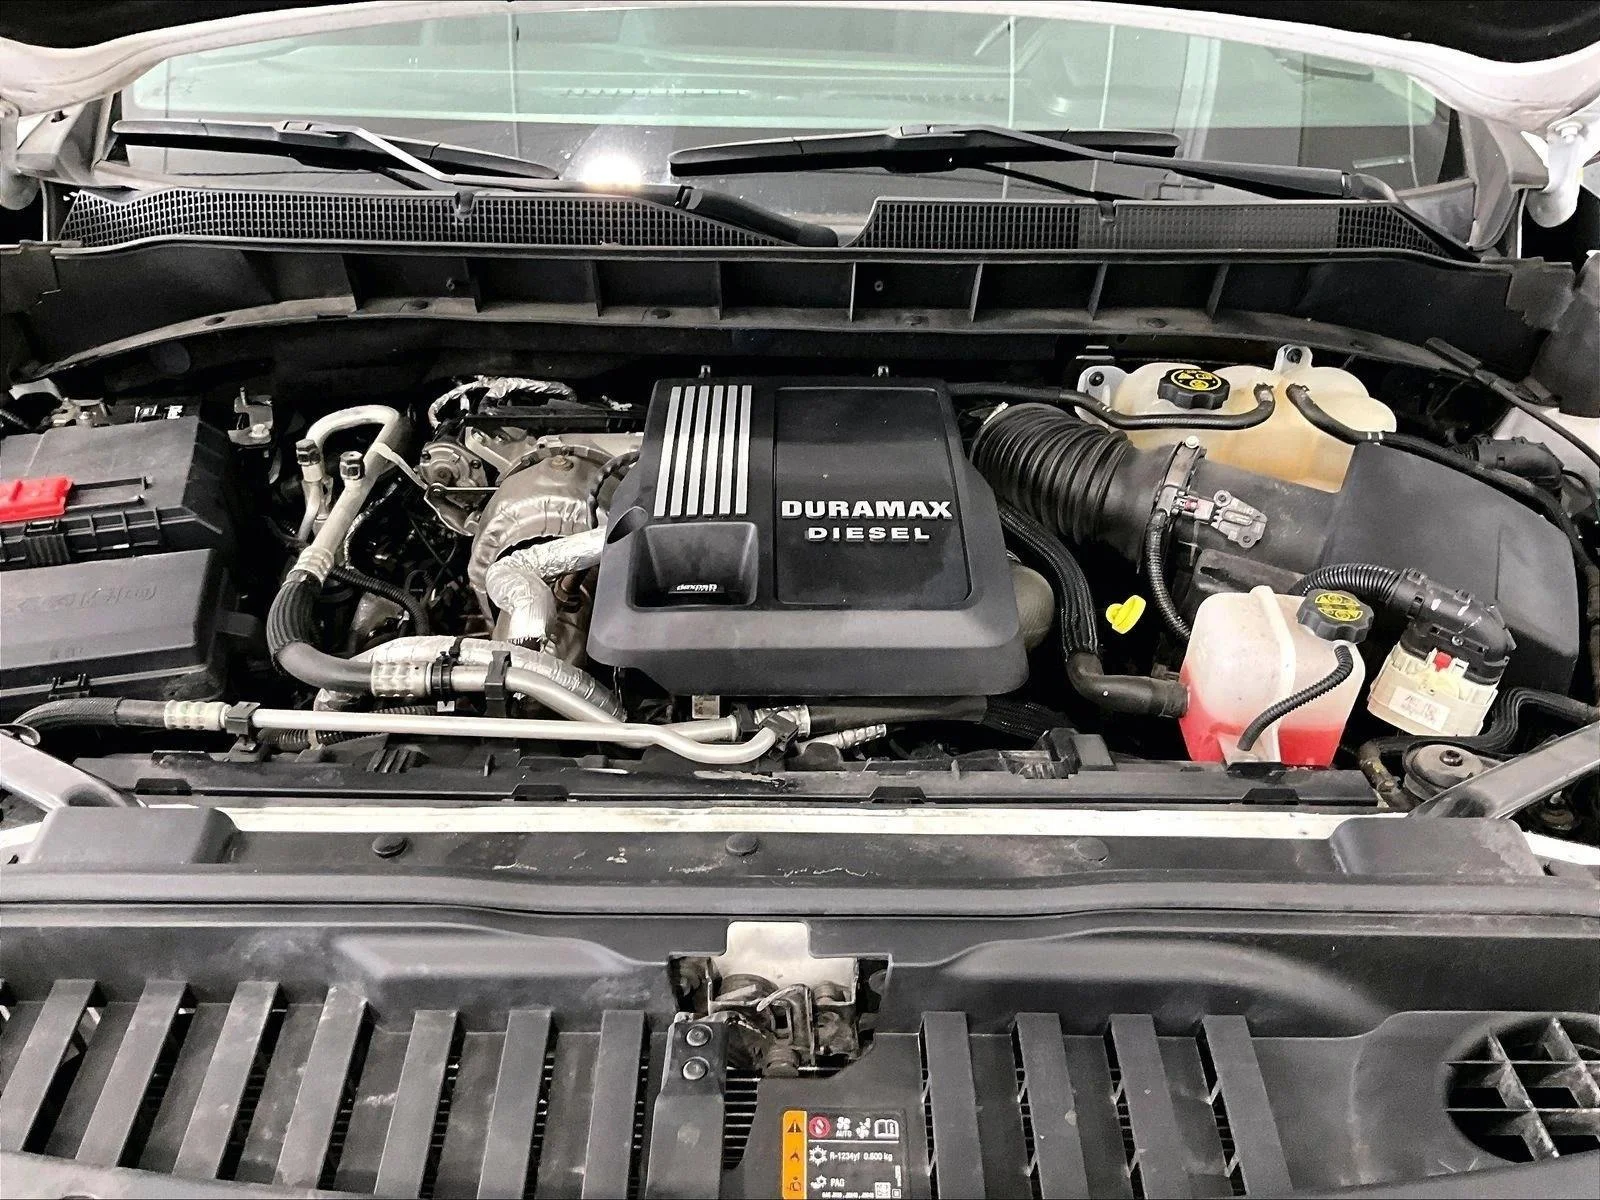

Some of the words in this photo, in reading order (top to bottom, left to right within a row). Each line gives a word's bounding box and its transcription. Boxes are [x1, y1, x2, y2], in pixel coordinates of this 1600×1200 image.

[781, 500, 953, 520] DURAMAX
[805, 527, 930, 542] DIESEL
[836, 1130, 852, 1138] AUTO
[830, 1152, 860, 1162] R-1234yf
[884, 1152, 892, 1162] kg
[830, 1178, 845, 1187] PAG
